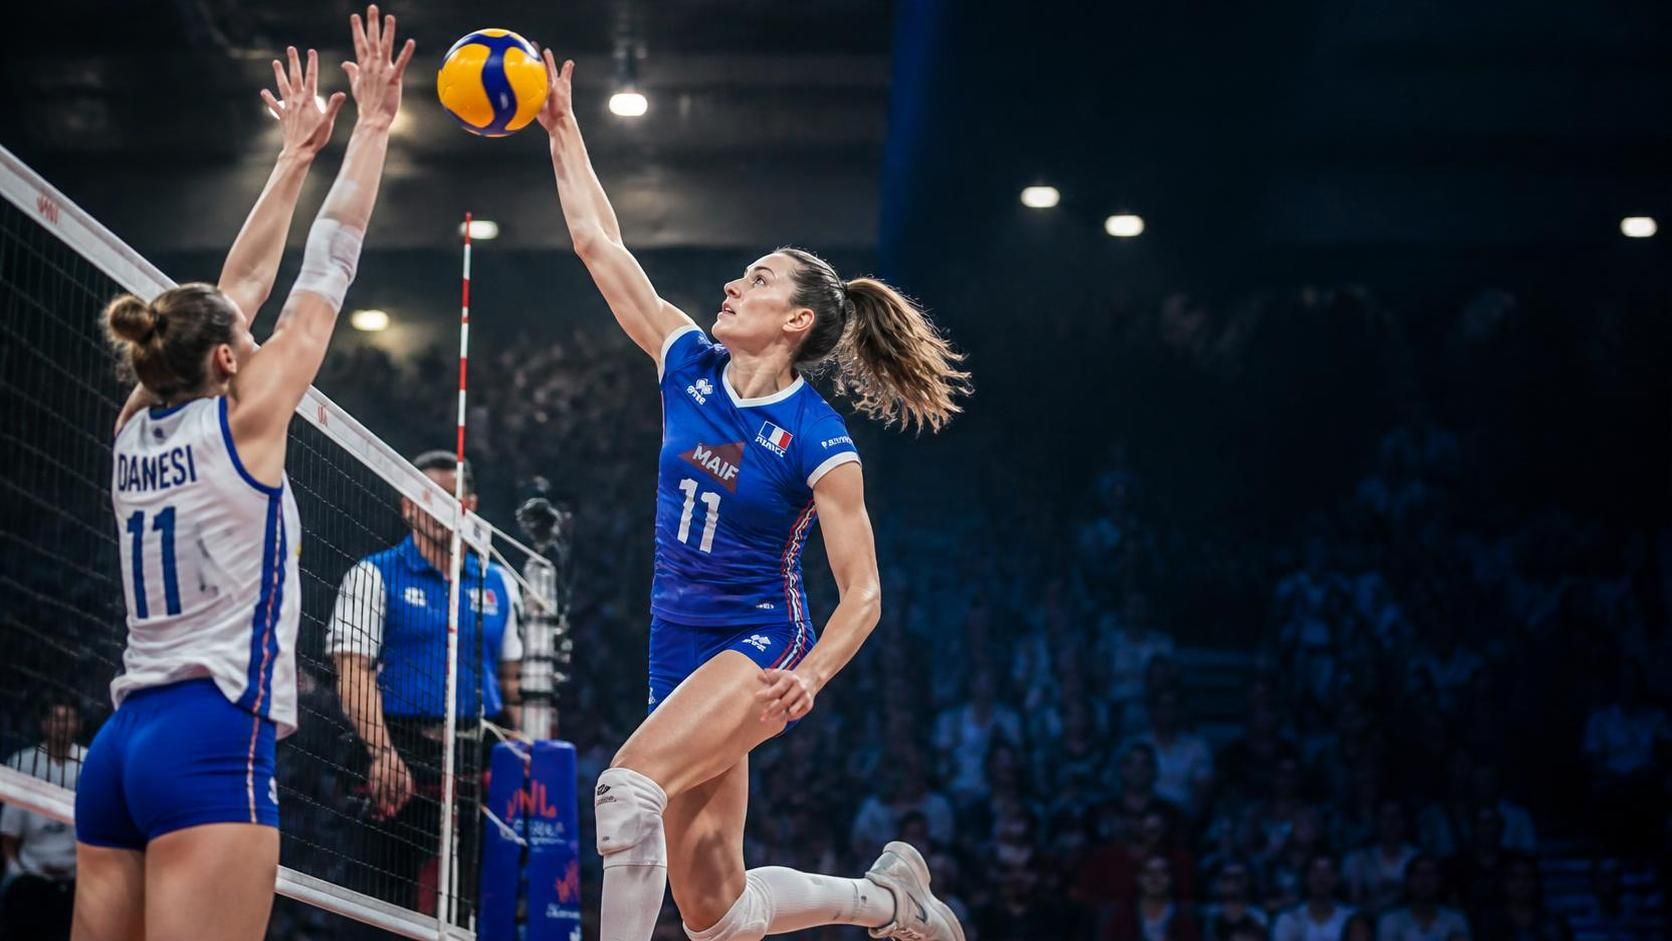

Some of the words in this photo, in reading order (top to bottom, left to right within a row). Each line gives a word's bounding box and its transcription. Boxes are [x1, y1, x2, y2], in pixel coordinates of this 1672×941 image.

[118, 445, 196, 491] DANESI
[692, 445, 740, 481] MAIF
[676, 477, 722, 554] 11
[127, 506, 182, 619] 11
